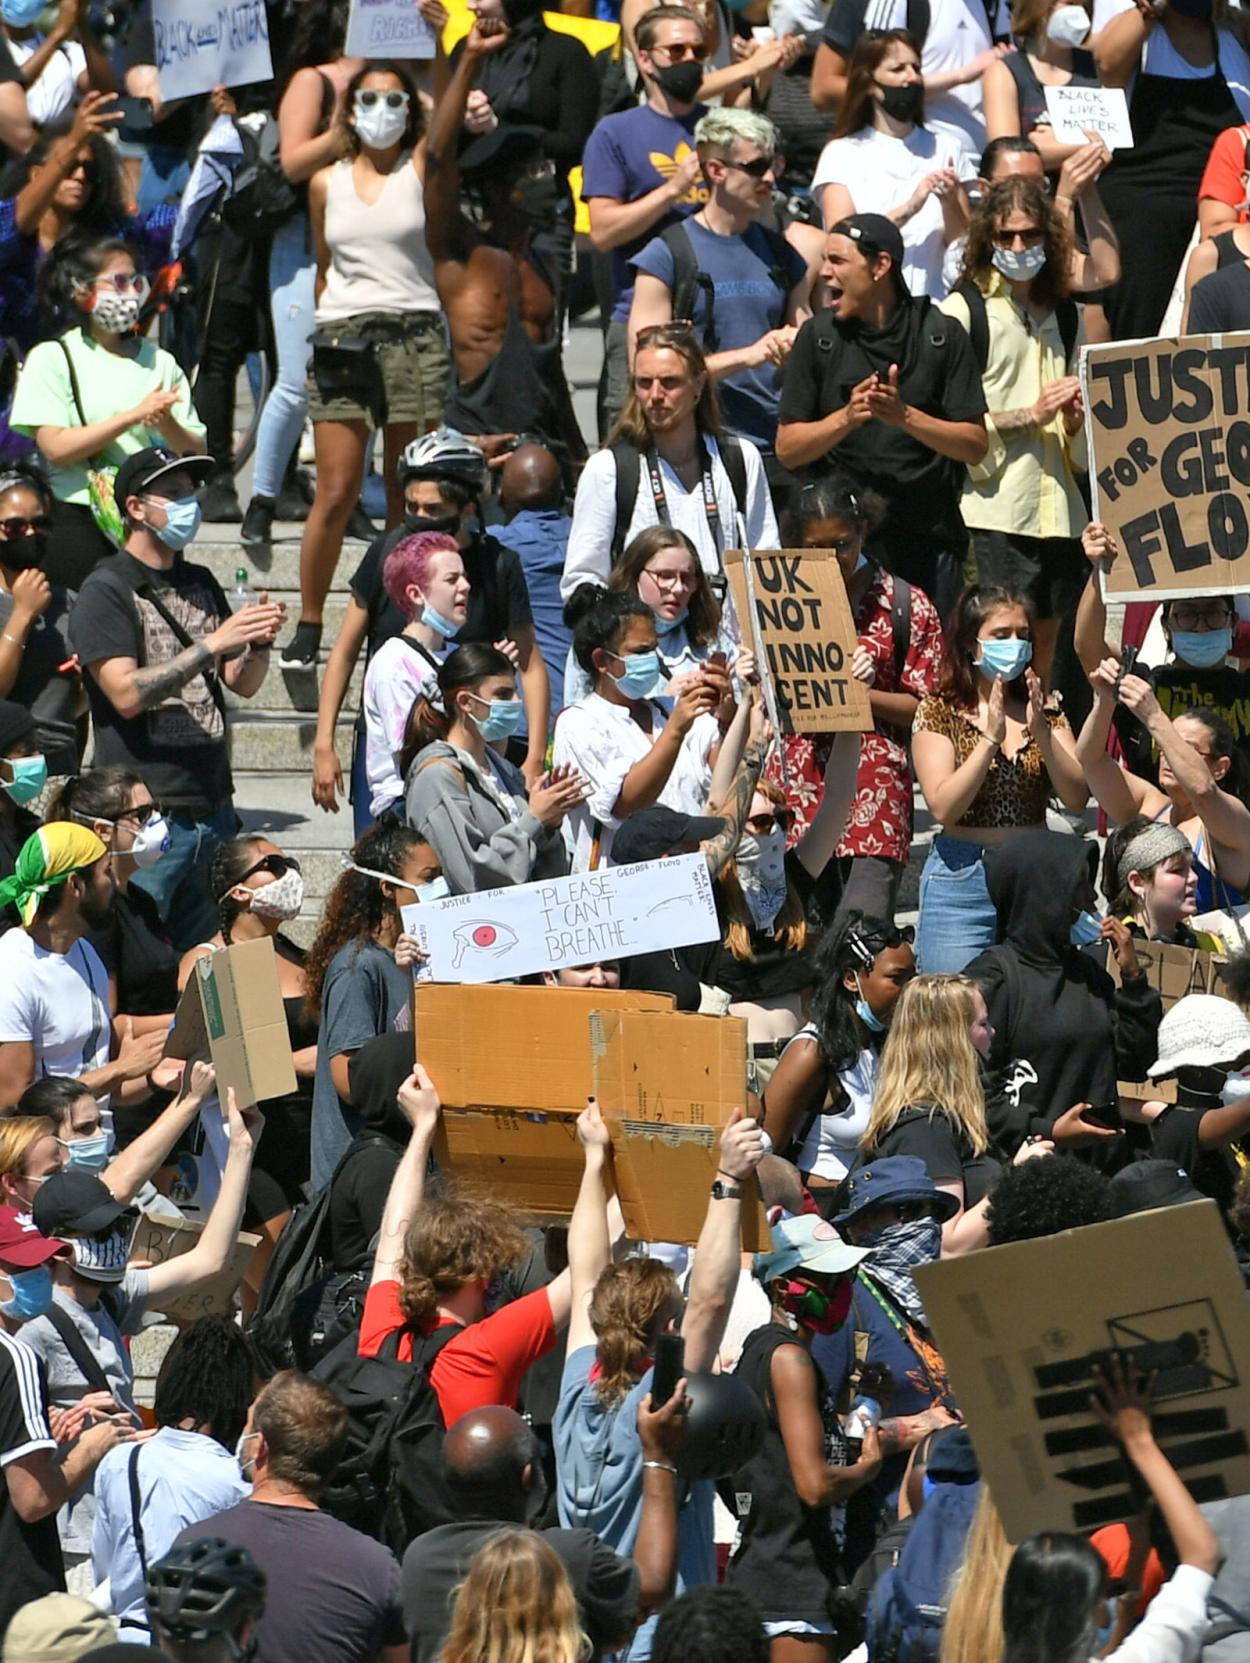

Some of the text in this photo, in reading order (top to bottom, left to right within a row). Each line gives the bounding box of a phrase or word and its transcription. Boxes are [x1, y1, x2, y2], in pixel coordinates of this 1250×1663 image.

[1058, 90, 1103, 103] BLACK
[1069, 106, 1109, 117] LIVES
[1063, 119, 1119, 132] MATTER
[1097, 437, 1157, 502] FOR
[755, 597, 822, 632] NOT
[775, 679, 848, 710] CENT
[440, 859, 681, 910] JUSTICE FOR GEORGE FLOYD
[539, 896, 615, 933] I CAN'T
